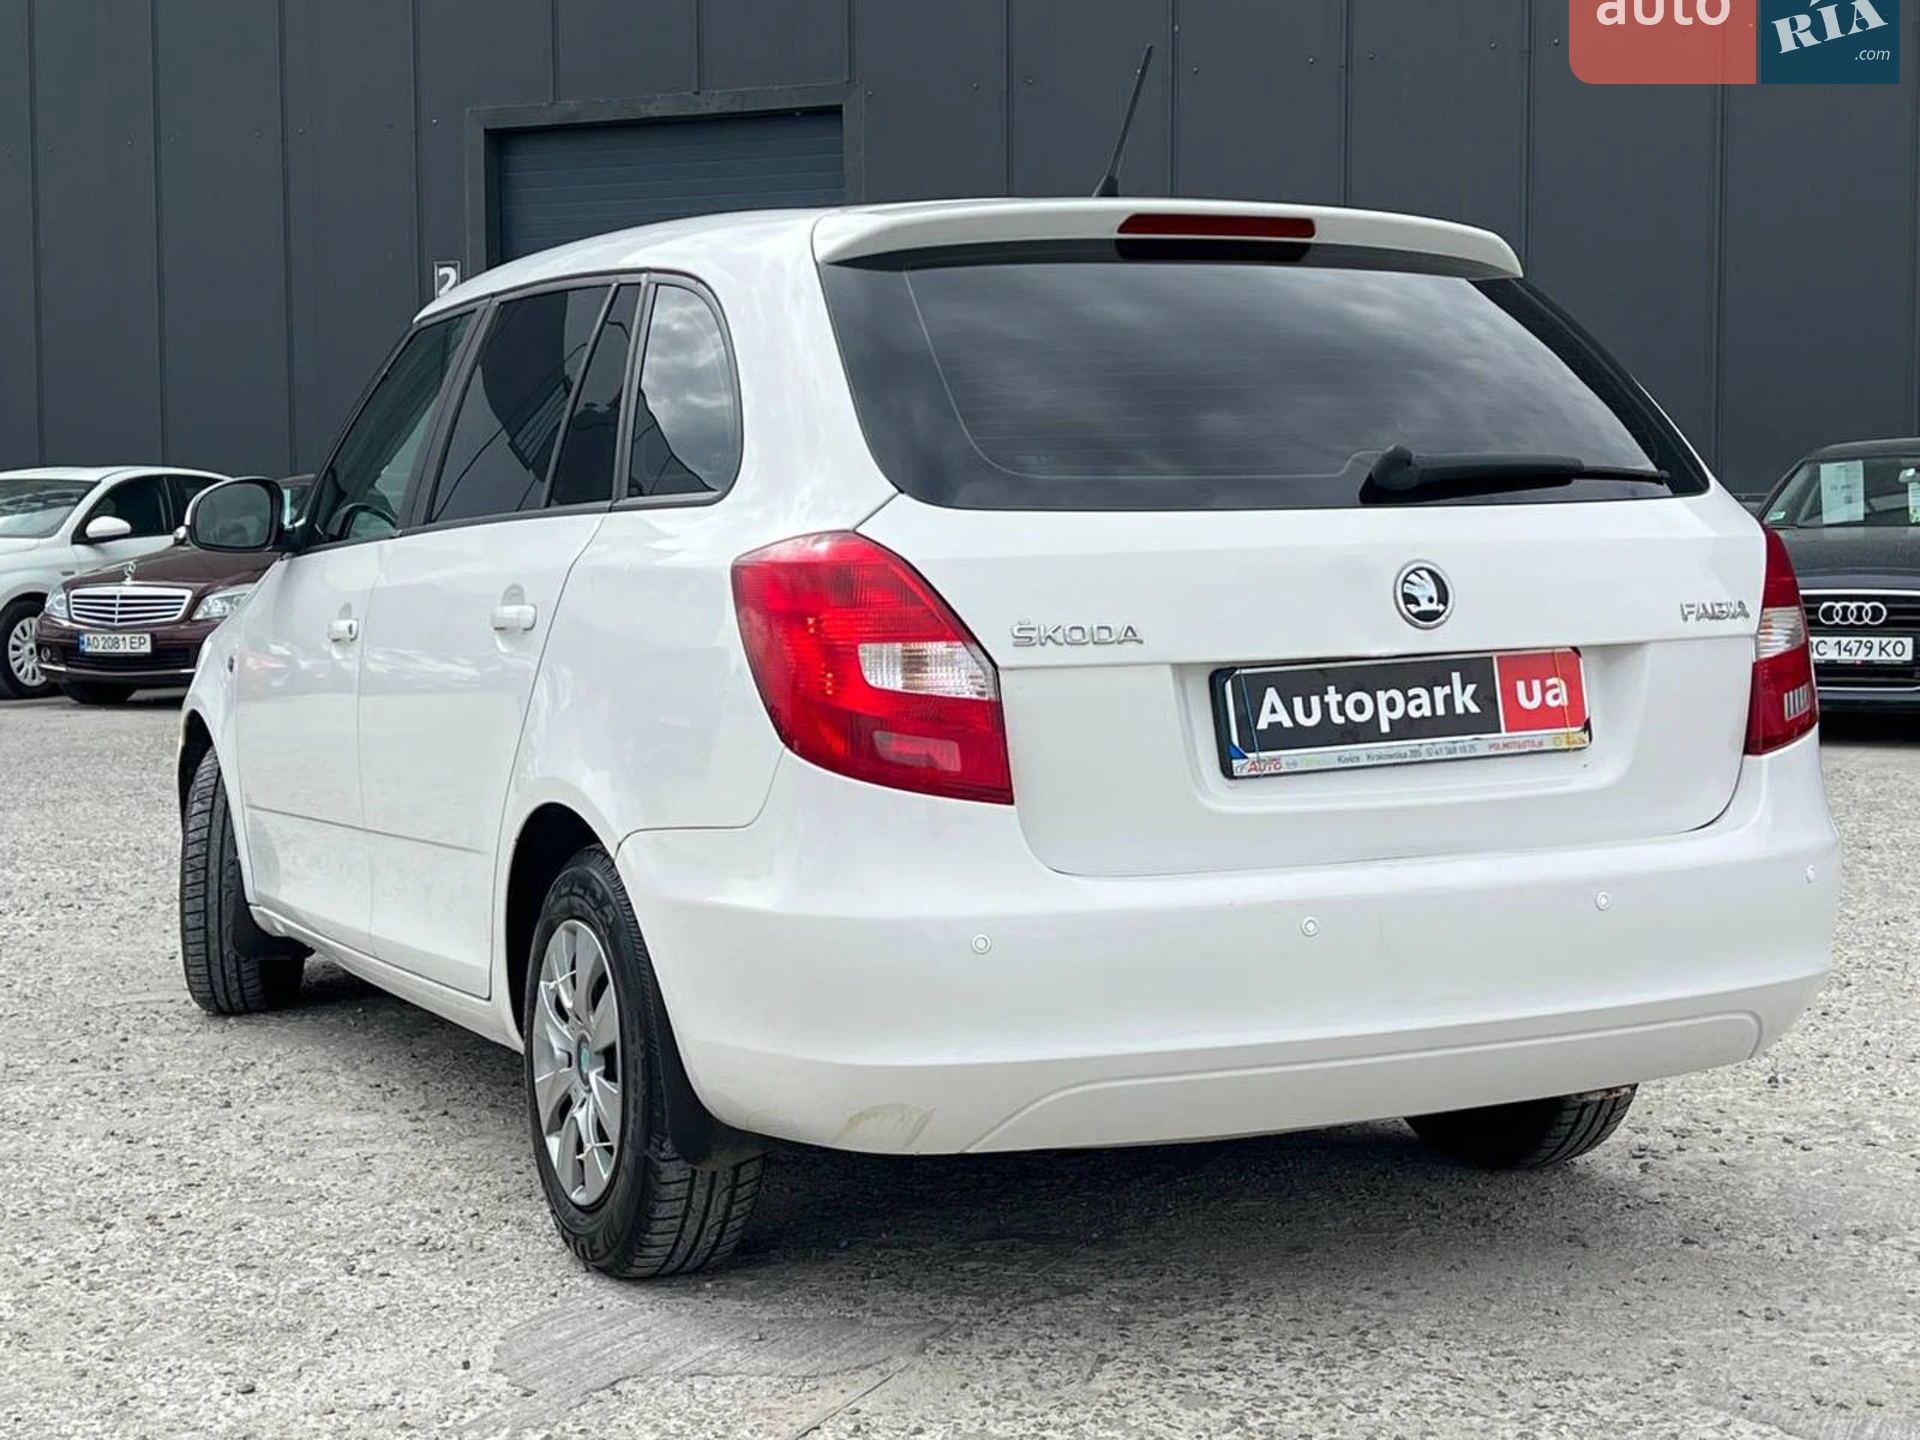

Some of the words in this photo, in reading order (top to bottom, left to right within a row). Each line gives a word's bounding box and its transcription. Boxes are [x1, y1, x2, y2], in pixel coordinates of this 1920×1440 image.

[438, 266, 457, 296] 2
[1680, 600, 1749, 621] FABIA
[101, 636, 127, 649] 2081
[129, 636, 147, 649] EP
[1012, 618, 1144, 647] ŠKODA
[1834, 640, 1873, 657] 1479
[1878, 640, 1905, 657] KO
[1256, 671, 1481, 733] Autopark
[1516, 677, 1569, 710] ua
